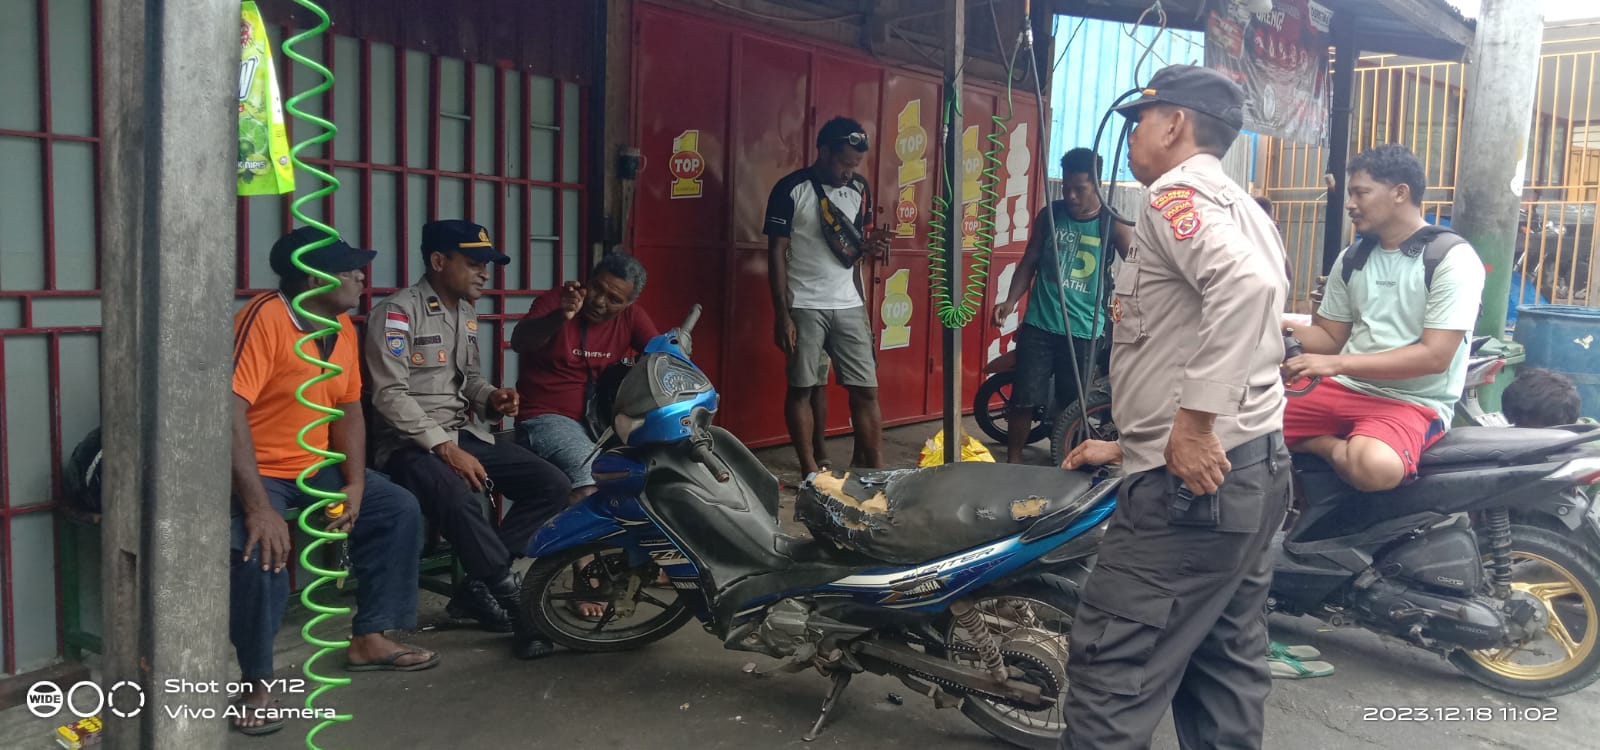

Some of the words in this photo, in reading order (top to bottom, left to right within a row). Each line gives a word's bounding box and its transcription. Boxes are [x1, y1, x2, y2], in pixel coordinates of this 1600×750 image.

[899, 134, 923, 154] TOP
[674, 158, 700, 173] TOP
[899, 206, 915, 219] TOP
[964, 221, 979, 232] TOP
[1071, 235, 1101, 278] 5
[884, 302, 909, 318] TOP
